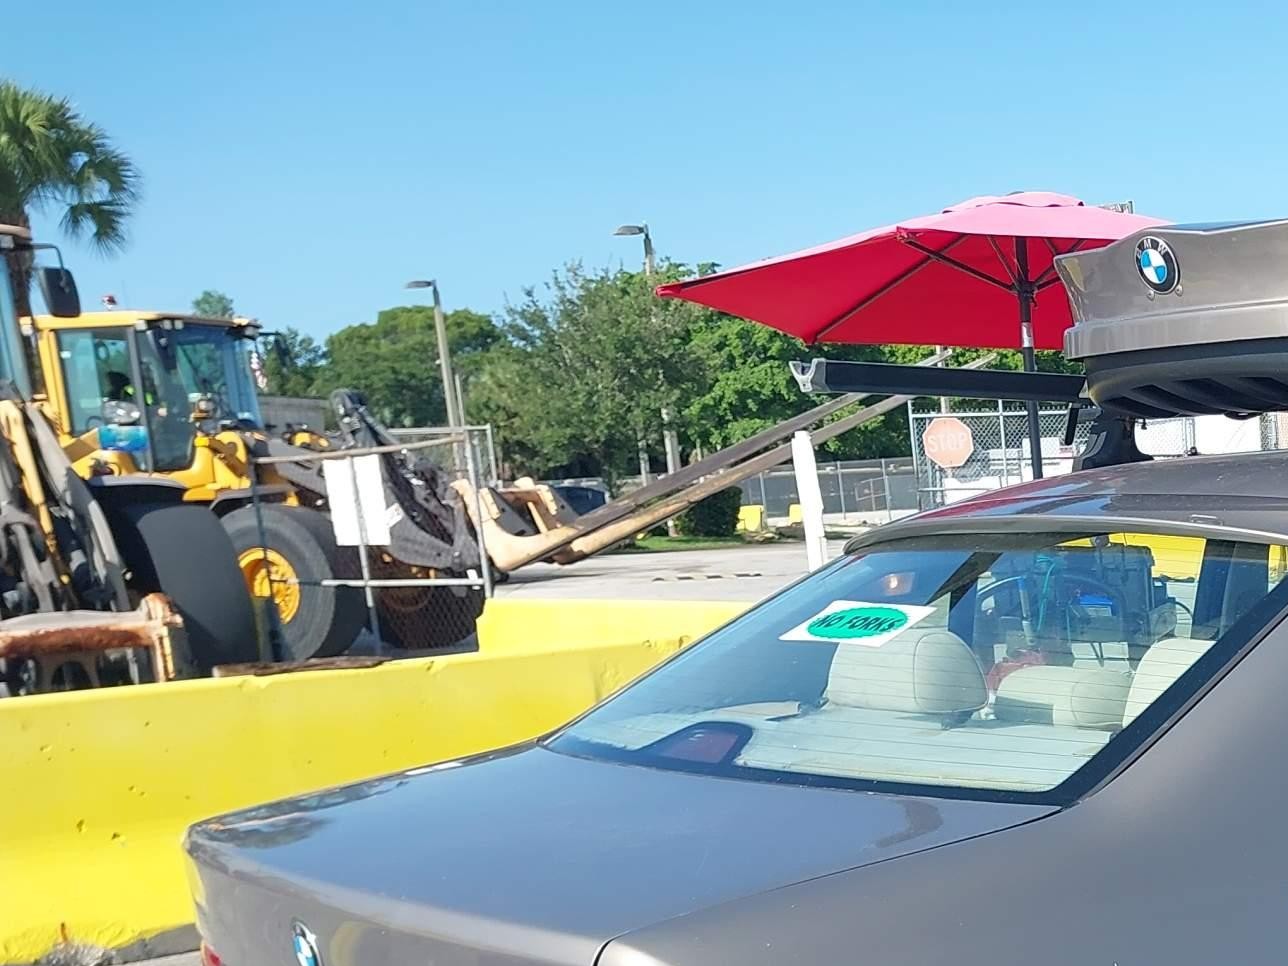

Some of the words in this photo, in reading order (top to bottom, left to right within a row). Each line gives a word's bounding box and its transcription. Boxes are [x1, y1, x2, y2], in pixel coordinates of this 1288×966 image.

[927, 431, 970, 453] STOP
[815, 614, 846, 628] NO
[839, 615, 903, 632] FORKS
